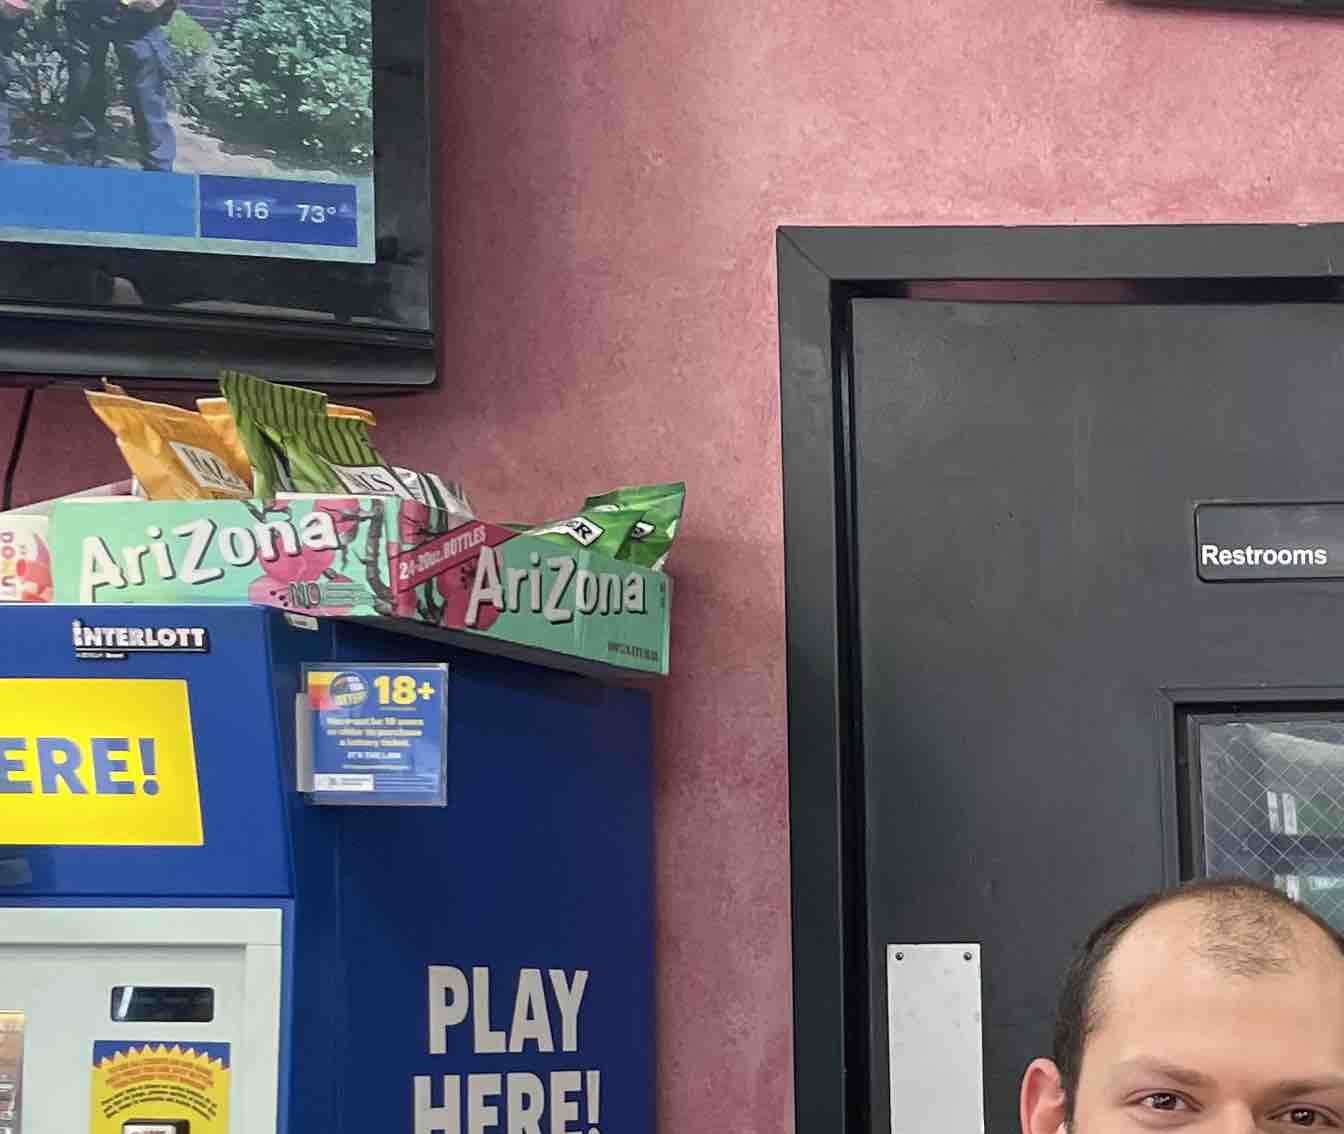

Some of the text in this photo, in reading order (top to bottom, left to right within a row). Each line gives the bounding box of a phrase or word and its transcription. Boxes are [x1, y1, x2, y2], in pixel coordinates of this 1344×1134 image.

[224, 199, 270, 219] 1:16
[80, 511, 343, 604] AriZona
[1201, 544, 1328, 566] Restrooms
[464, 544, 647, 627] AriZona
[374, 675, 436, 705] 18+
[0, 737, 160, 796] ERE!
[427, 964, 590, 1055] PLAY
